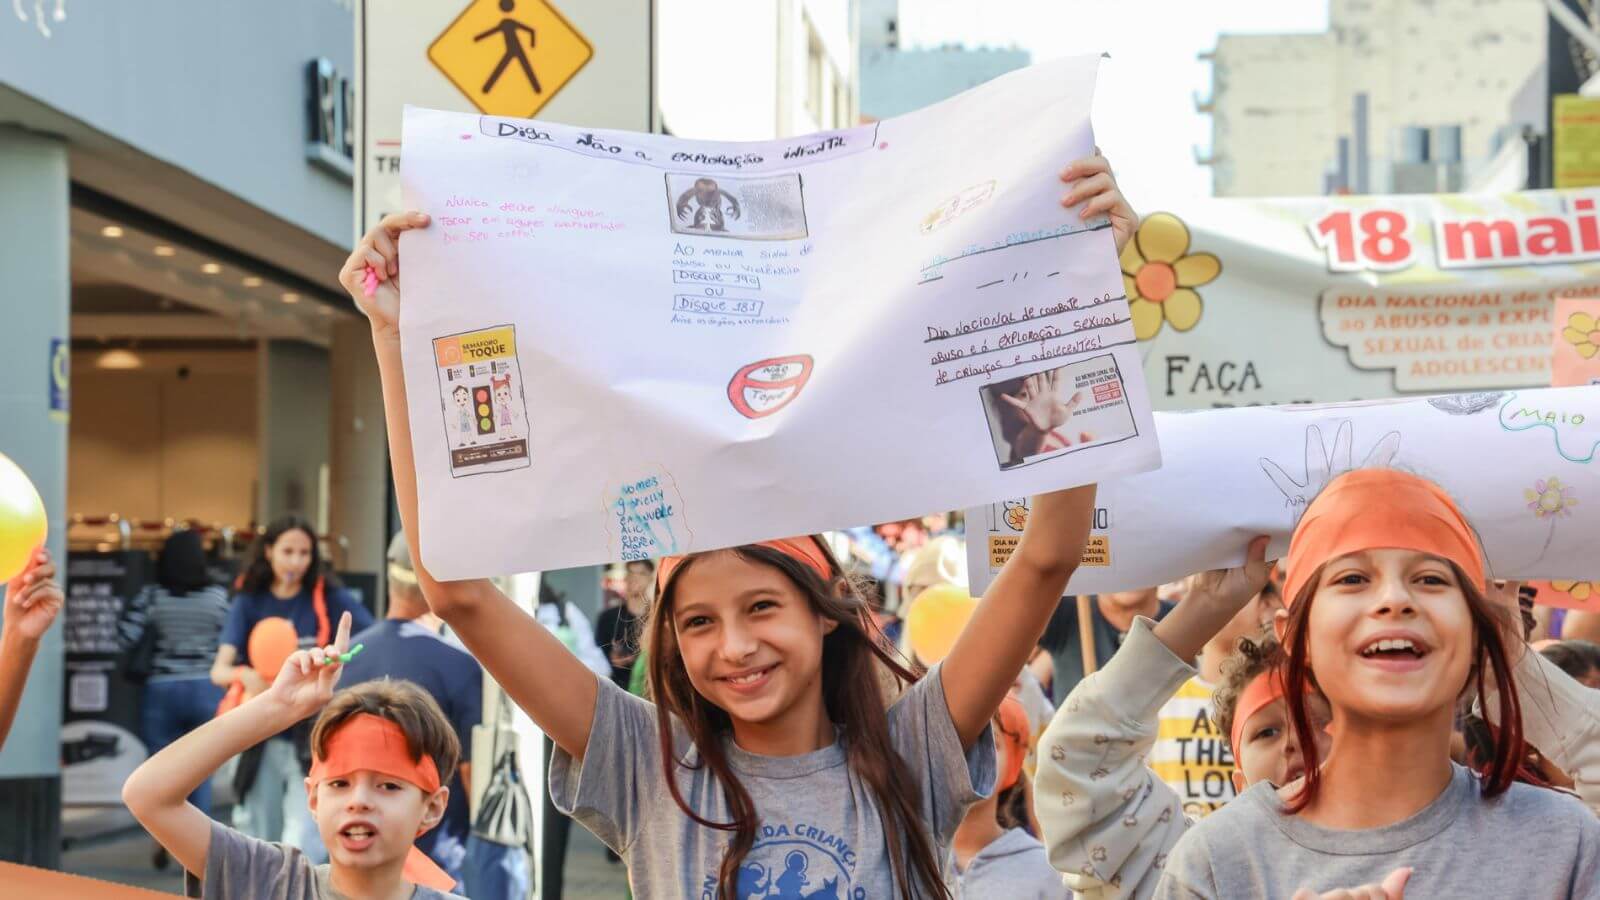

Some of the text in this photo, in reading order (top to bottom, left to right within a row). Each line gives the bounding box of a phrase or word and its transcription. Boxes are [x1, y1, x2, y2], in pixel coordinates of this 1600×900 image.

[499, 122, 554, 141] Diga
[576, 132, 622, 154] Não
[635, 151, 652, 161] a
[1318, 198, 1600, 264] 18 mai
[673, 242, 695, 257] AO
[704, 287, 725, 297] OU
[1337, 294, 1378, 309] DIA
[1386, 291, 1504, 309] NACIONAL
[1512, 289, 1540, 305] de
[732, 301, 756, 313] 181
[926, 325, 951, 341] Dia
[1022, 306, 1035, 322] de
[1093, 293, 1111, 306] ao
[1373, 312, 1450, 329] ABUSO
[469, 343, 506, 358] TOQUE
[1165, 356, 1263, 396] FAÇA
[1409, 356, 1553, 378] ADOLESCEN
[1509, 407, 1585, 425] MAIO
[1092, 507, 1109, 530] IO
[762, 824, 791, 839] DA
